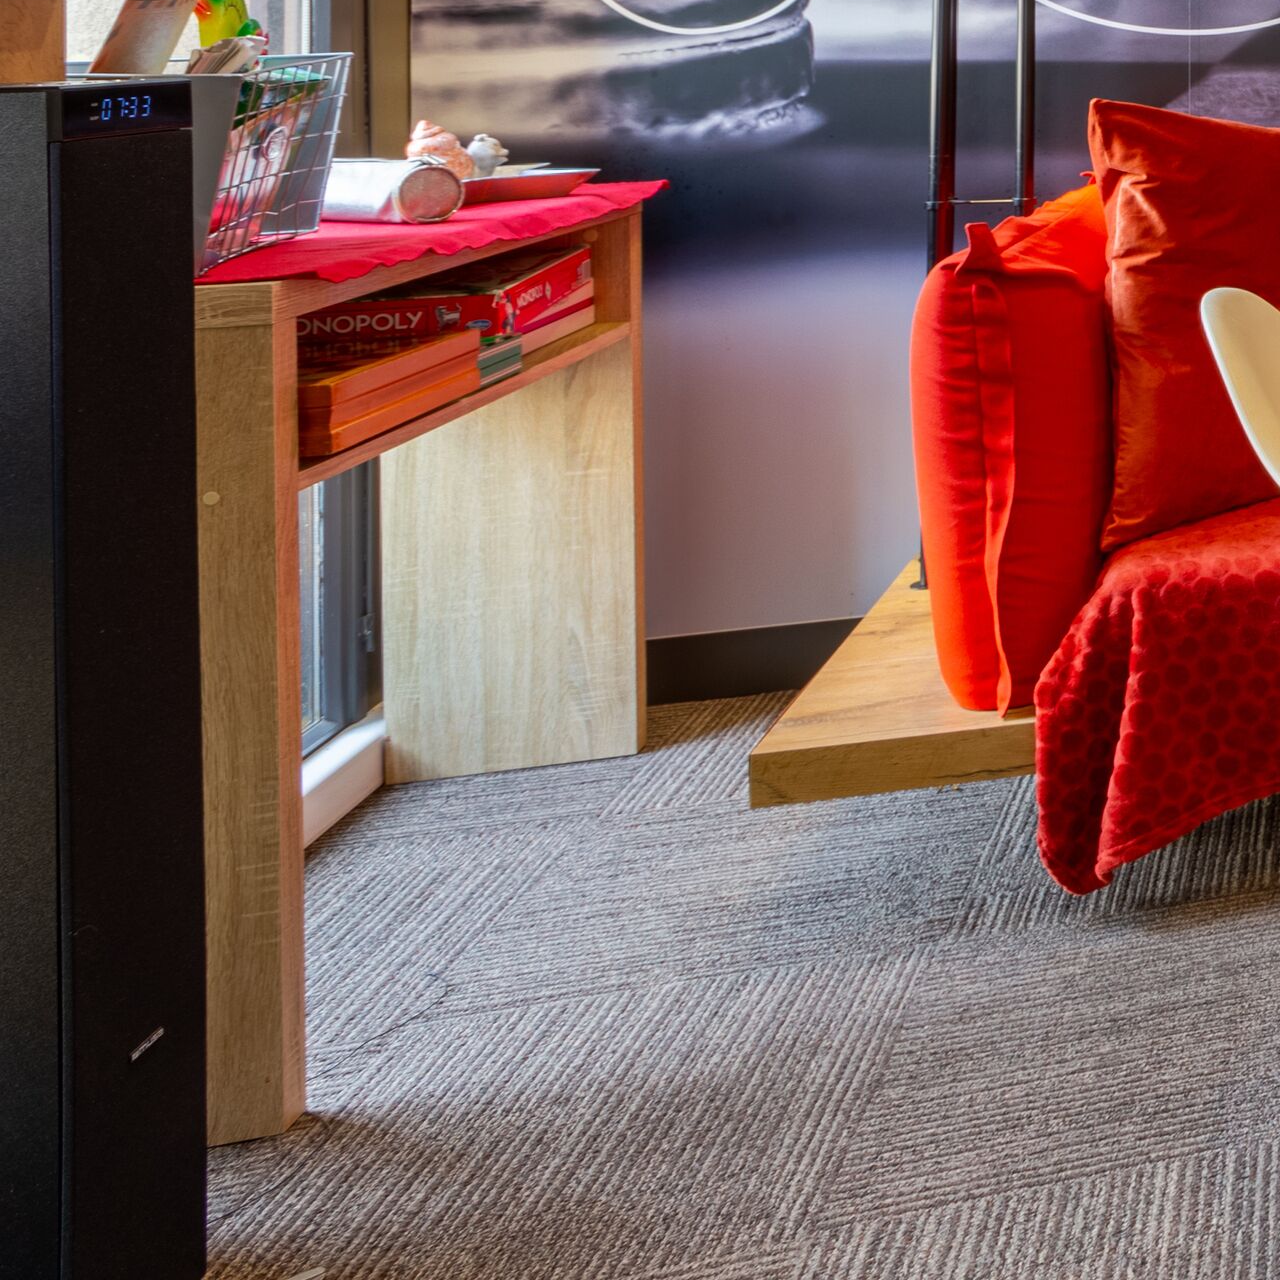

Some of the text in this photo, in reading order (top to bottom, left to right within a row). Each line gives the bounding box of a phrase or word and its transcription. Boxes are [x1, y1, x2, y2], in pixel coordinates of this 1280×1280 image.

[101, 95, 151, 120] 07:33
[516, 284, 544, 308] MONOPOLY
[297, 311, 423, 336] ONOPOLY
